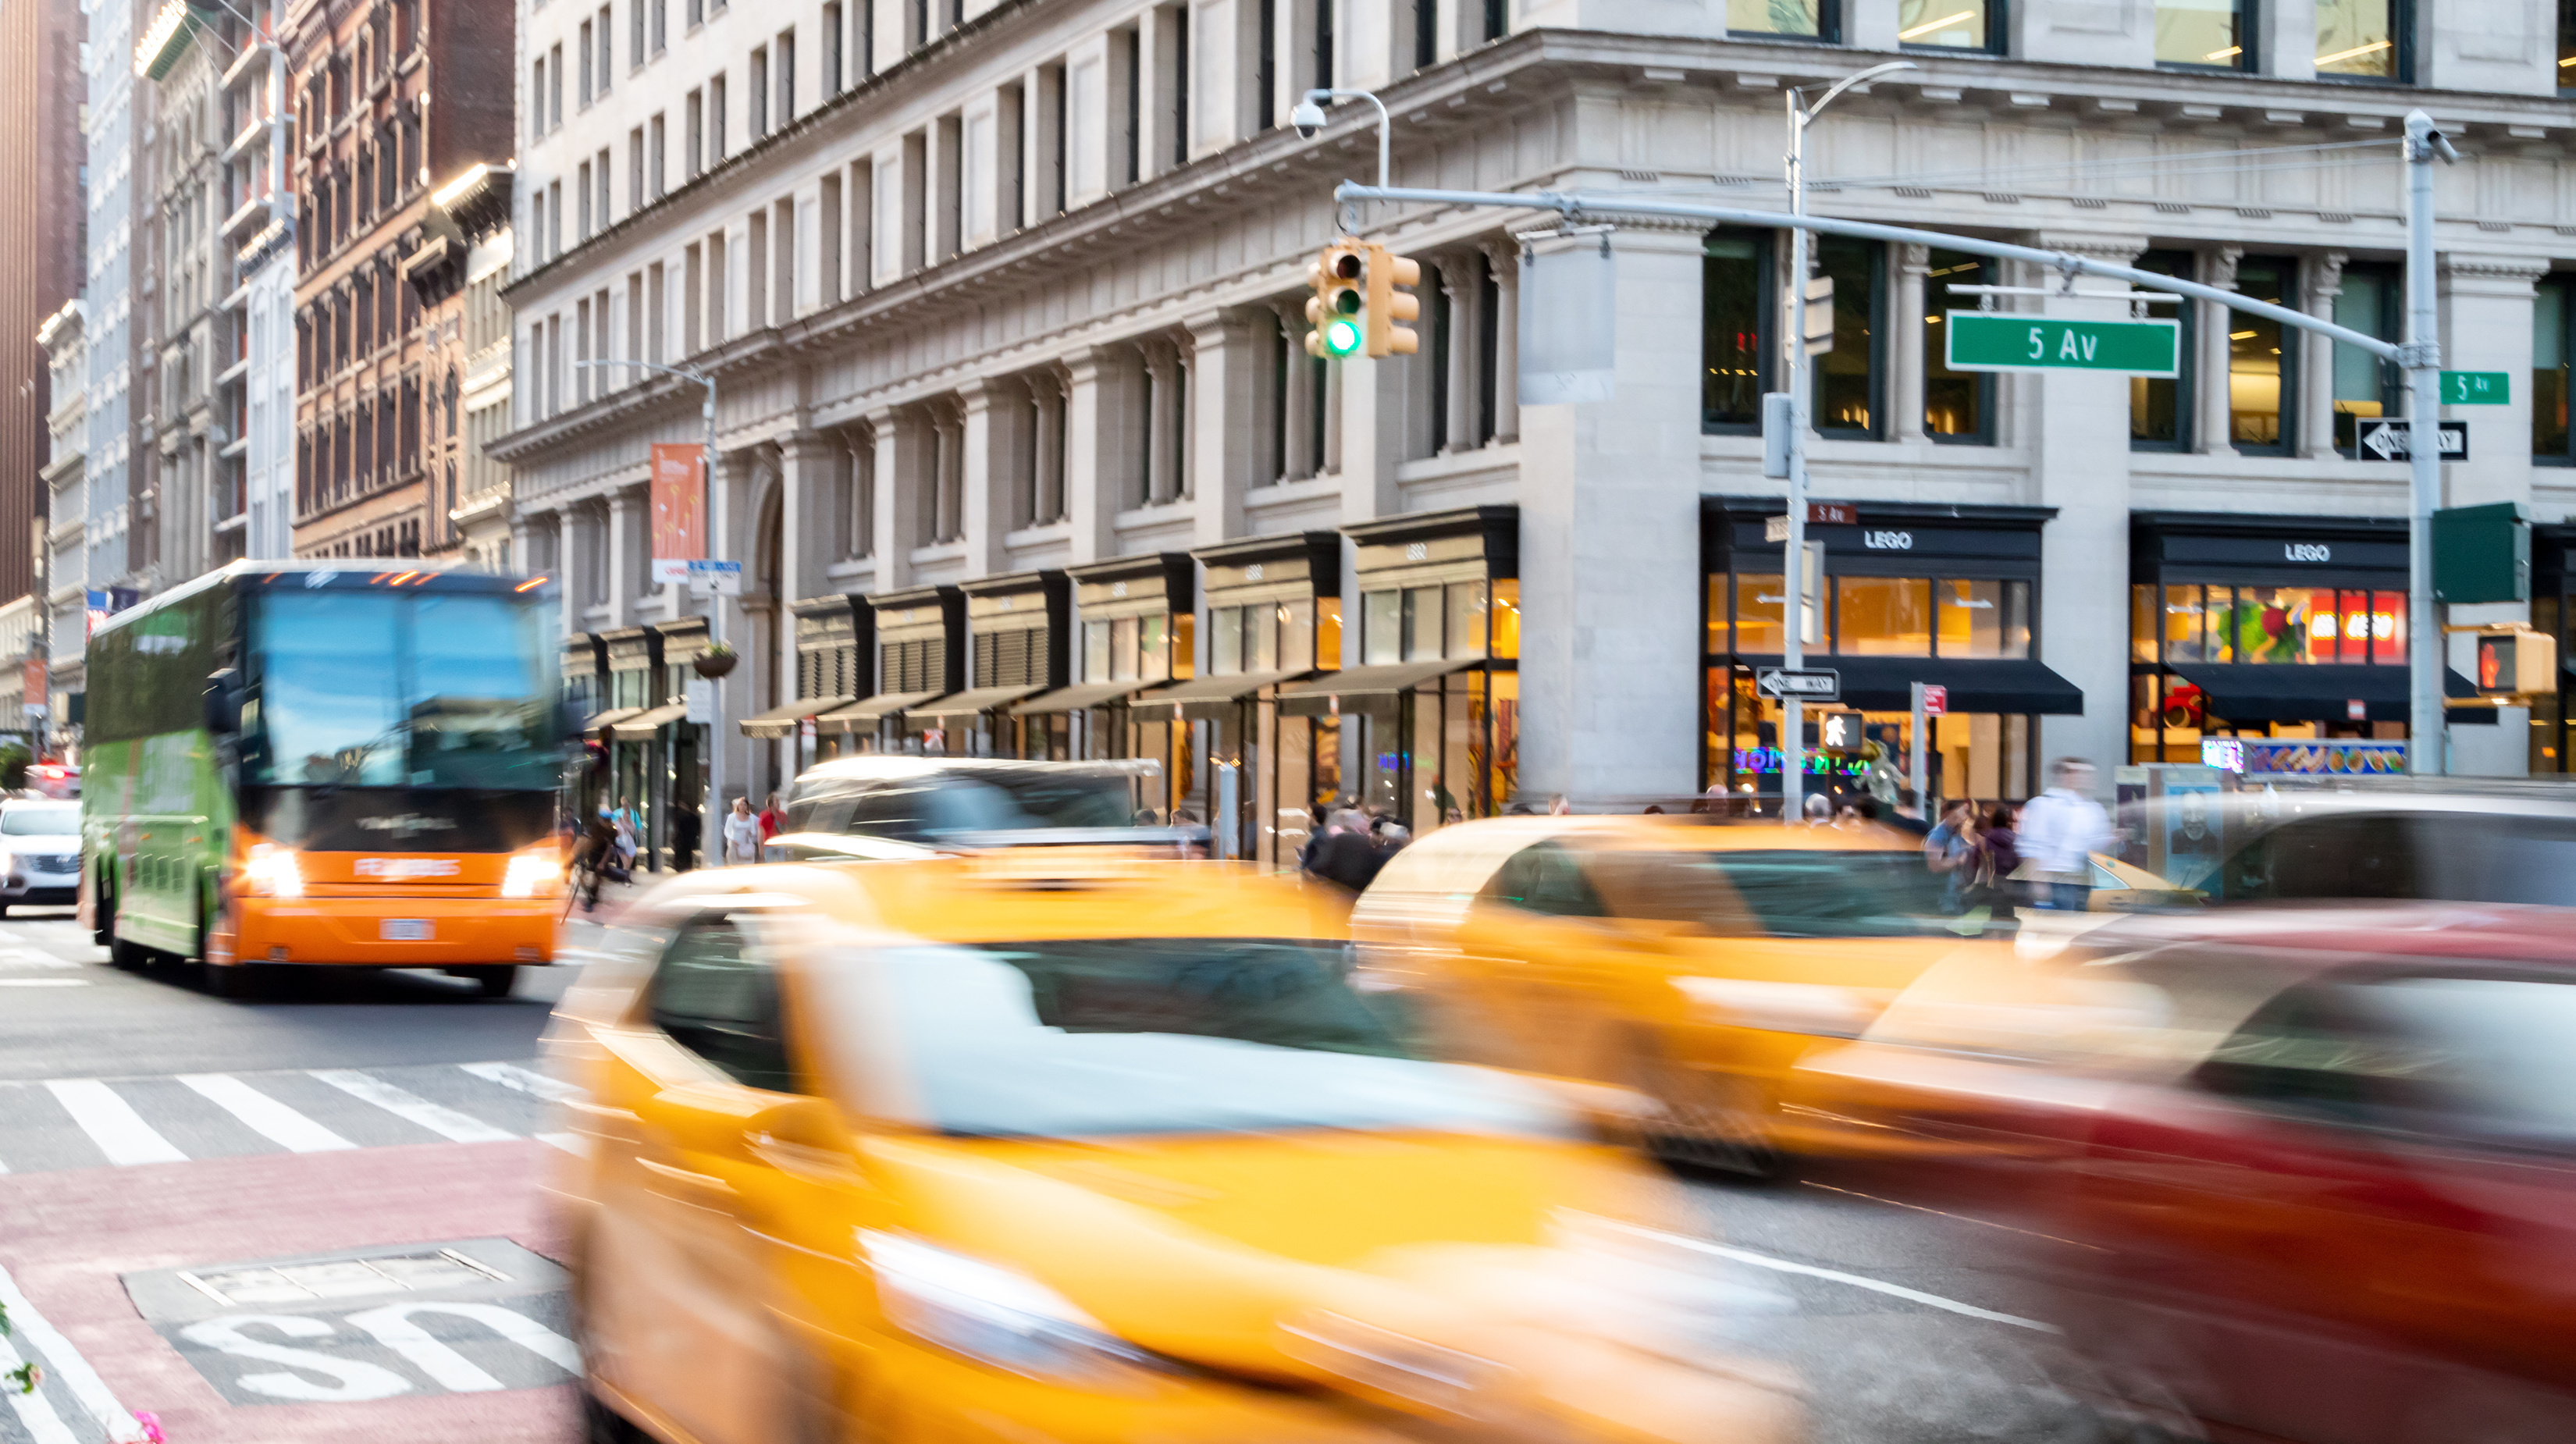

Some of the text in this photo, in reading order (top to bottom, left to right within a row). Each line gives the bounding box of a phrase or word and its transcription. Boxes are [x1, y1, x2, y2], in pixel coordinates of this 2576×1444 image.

[2028, 327, 2044, 360] 5
[2457, 375, 2468, 400] 5
[1818, 505, 1827, 521] 5
[1864, 530, 1912, 550] LEGO
[2285, 543, 2331, 562] LEGO
